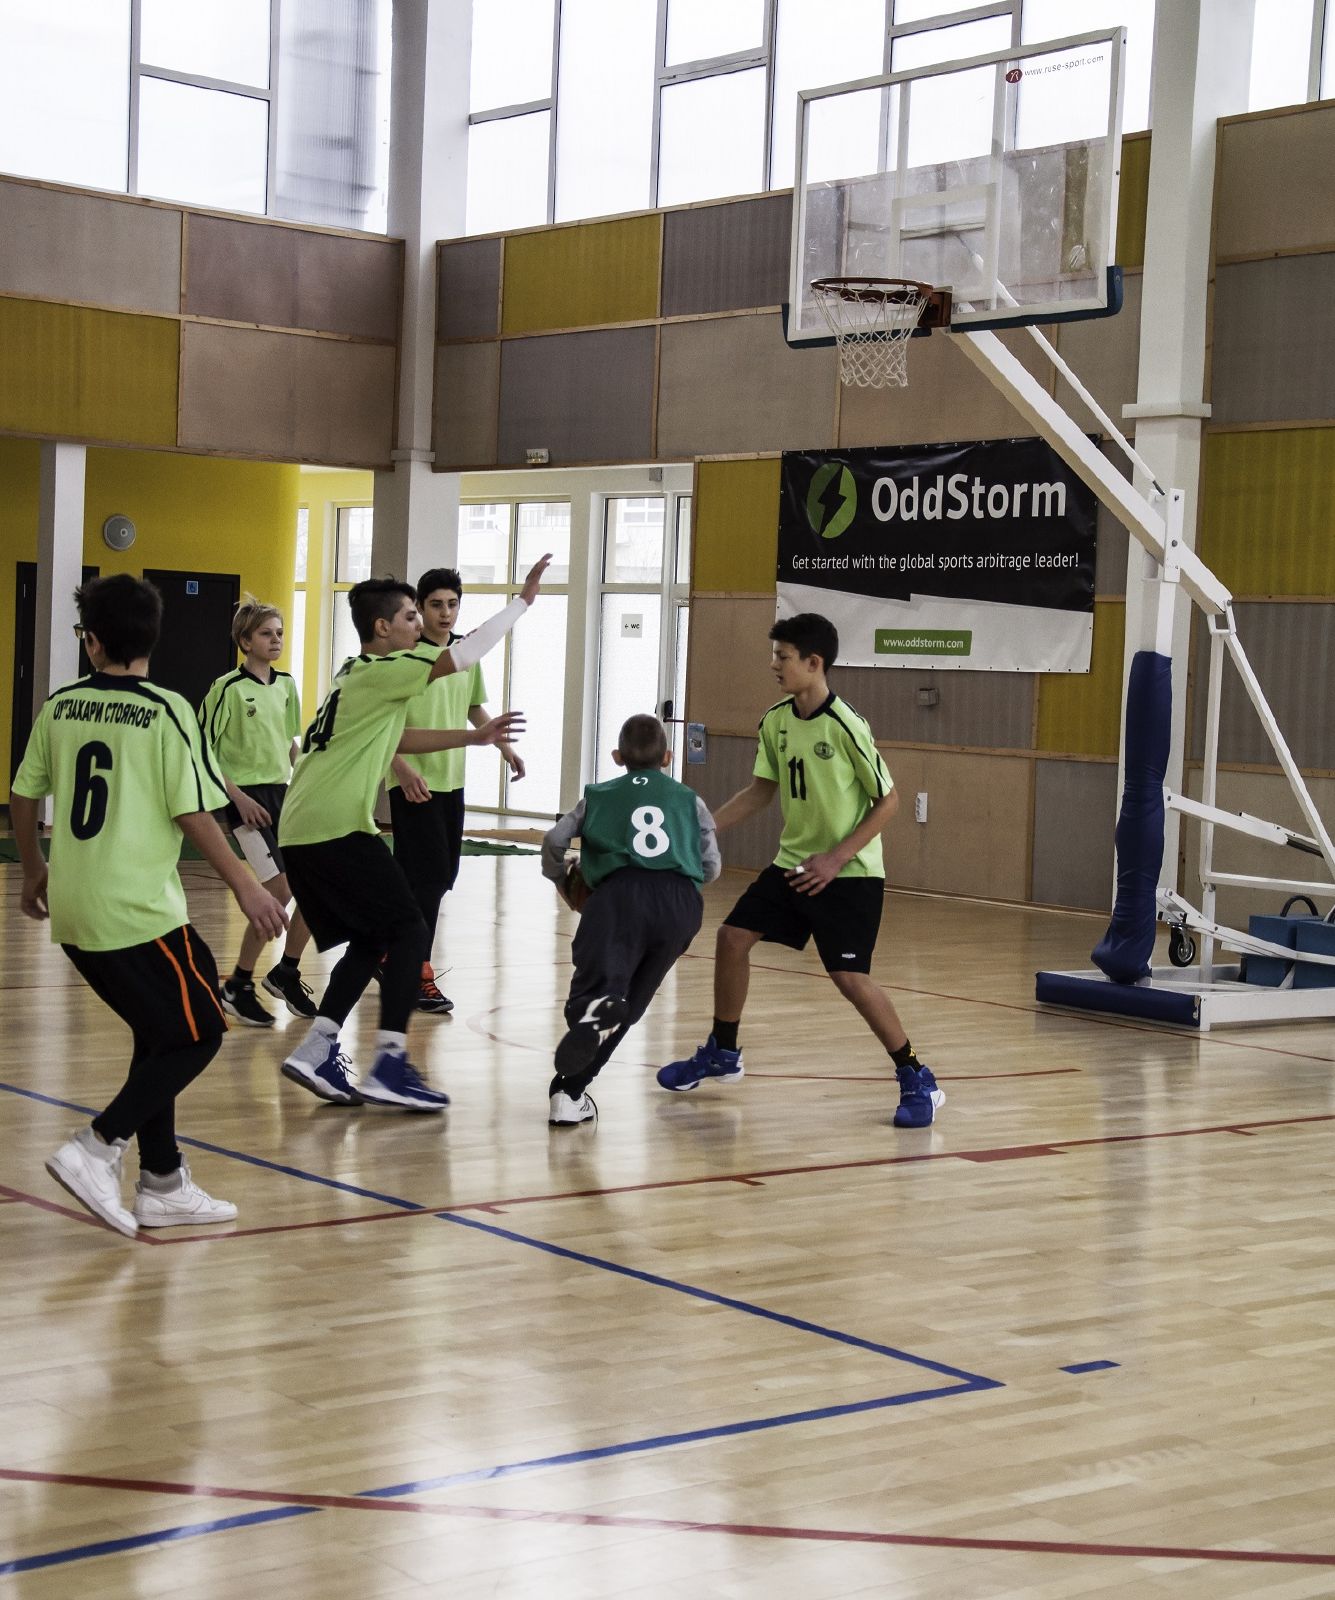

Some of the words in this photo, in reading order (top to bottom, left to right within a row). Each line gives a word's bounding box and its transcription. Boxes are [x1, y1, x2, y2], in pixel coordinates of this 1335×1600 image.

[1024, 55, 1105, 76] www.ruse-sport.com
[871, 473, 1067, 522] OddStorm
[792, 554, 810, 569] Get
[811, 554, 849, 569] started
[852, 554, 875, 569] with
[879, 554, 897, 569] the
[899, 553, 935, 572] global
[938, 554, 974, 571] sports
[976, 552, 1031, 571] arbitrage
[1035, 552, 1079, 568] leader!
[883, 637, 964, 649] www.oddstorm.com
[70, 740, 113, 841] 6
[788, 755, 807, 801] 11
[631, 805, 670, 858] 8
